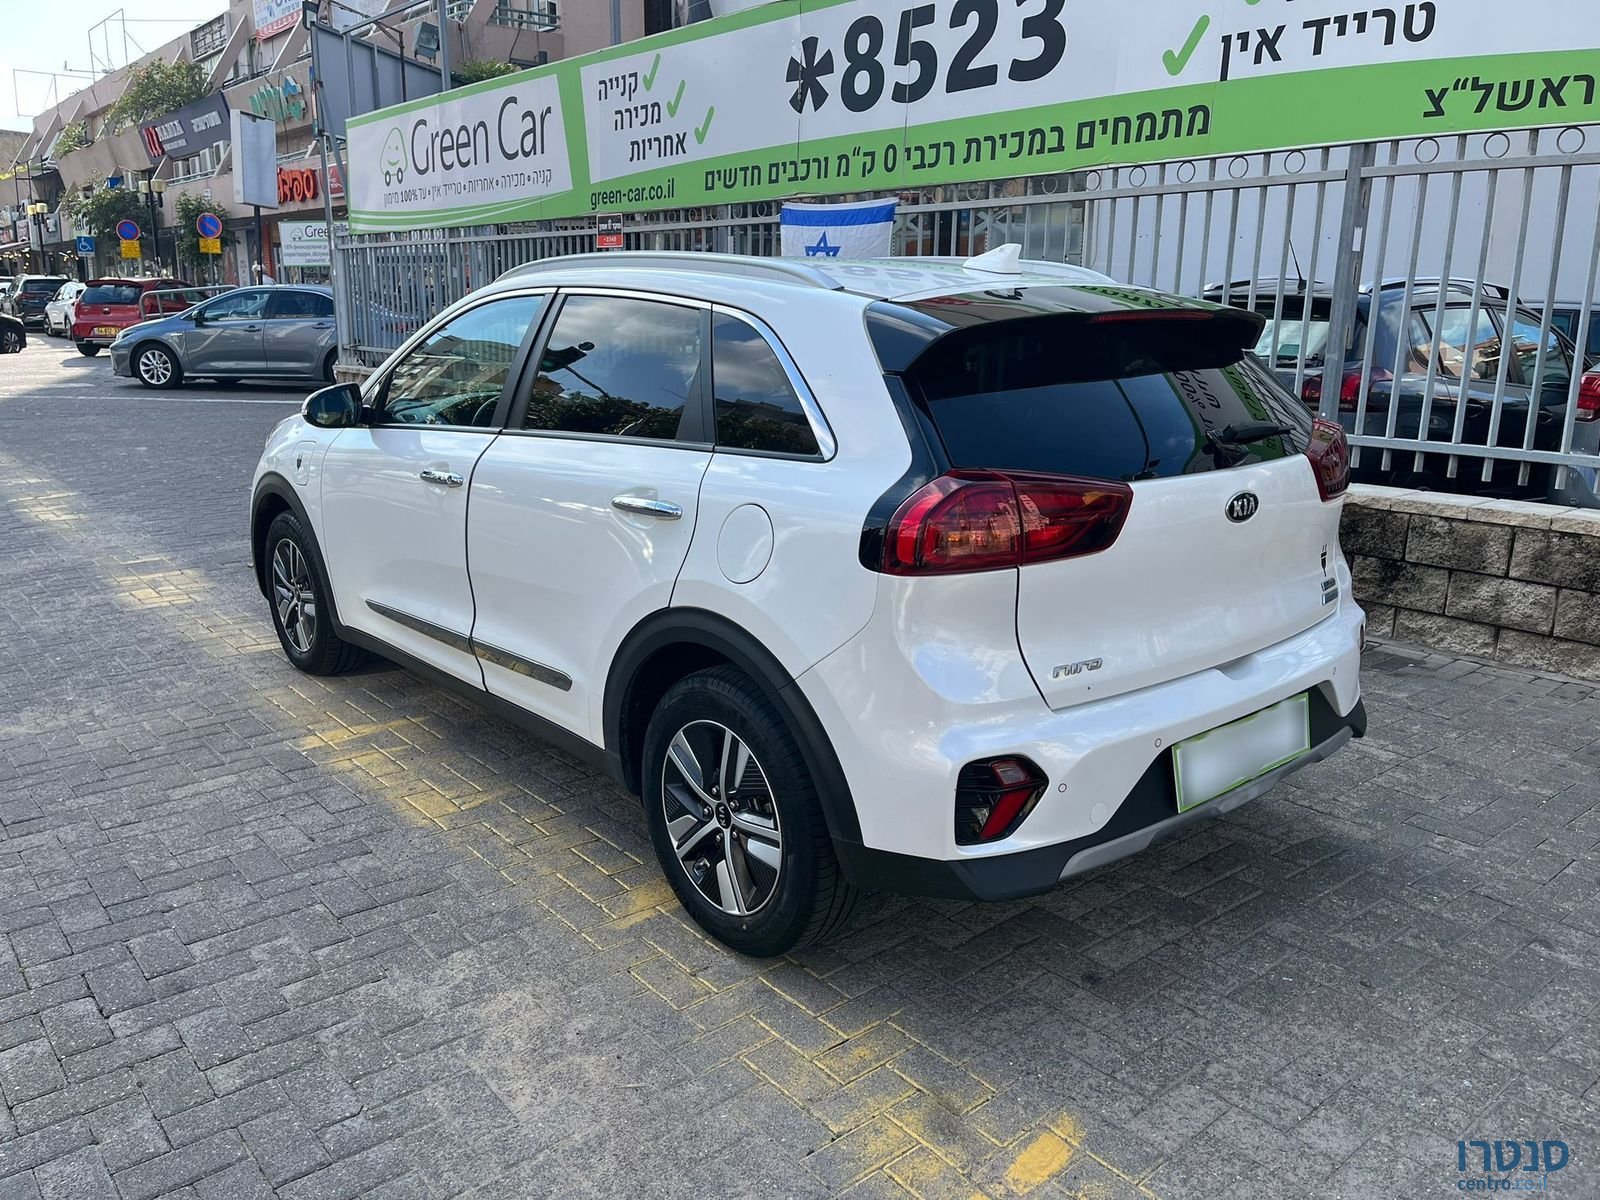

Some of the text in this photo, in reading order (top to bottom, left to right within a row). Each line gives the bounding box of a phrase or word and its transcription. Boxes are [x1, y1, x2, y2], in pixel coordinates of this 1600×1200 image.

[1219, 2, 1436, 81] טרייד אין
[598, 72, 638, 101] קנייה
[614, 101, 661, 131] מכירה
[1076, 104, 1210, 150] מתמחים
[411, 96, 552, 175] Green Car
[629, 132, 687, 162] אחריות
[963, 126, 1065, 164] במכירת
[768, 156, 829, 184] ורכבים
[905, 141, 956, 171] רכבי
[467, 177, 494, 193] אחריות
[501, 172, 525, 188] מכירה
[532, 169, 552, 187] קניה
[705, 165, 761, 191] חדשים
[401, 189, 418, 202] 100%
[590, 178, 675, 210] green-car.co.il
[304, 225, 328, 238] Gree
[1233, 497, 1255, 518] KIA
